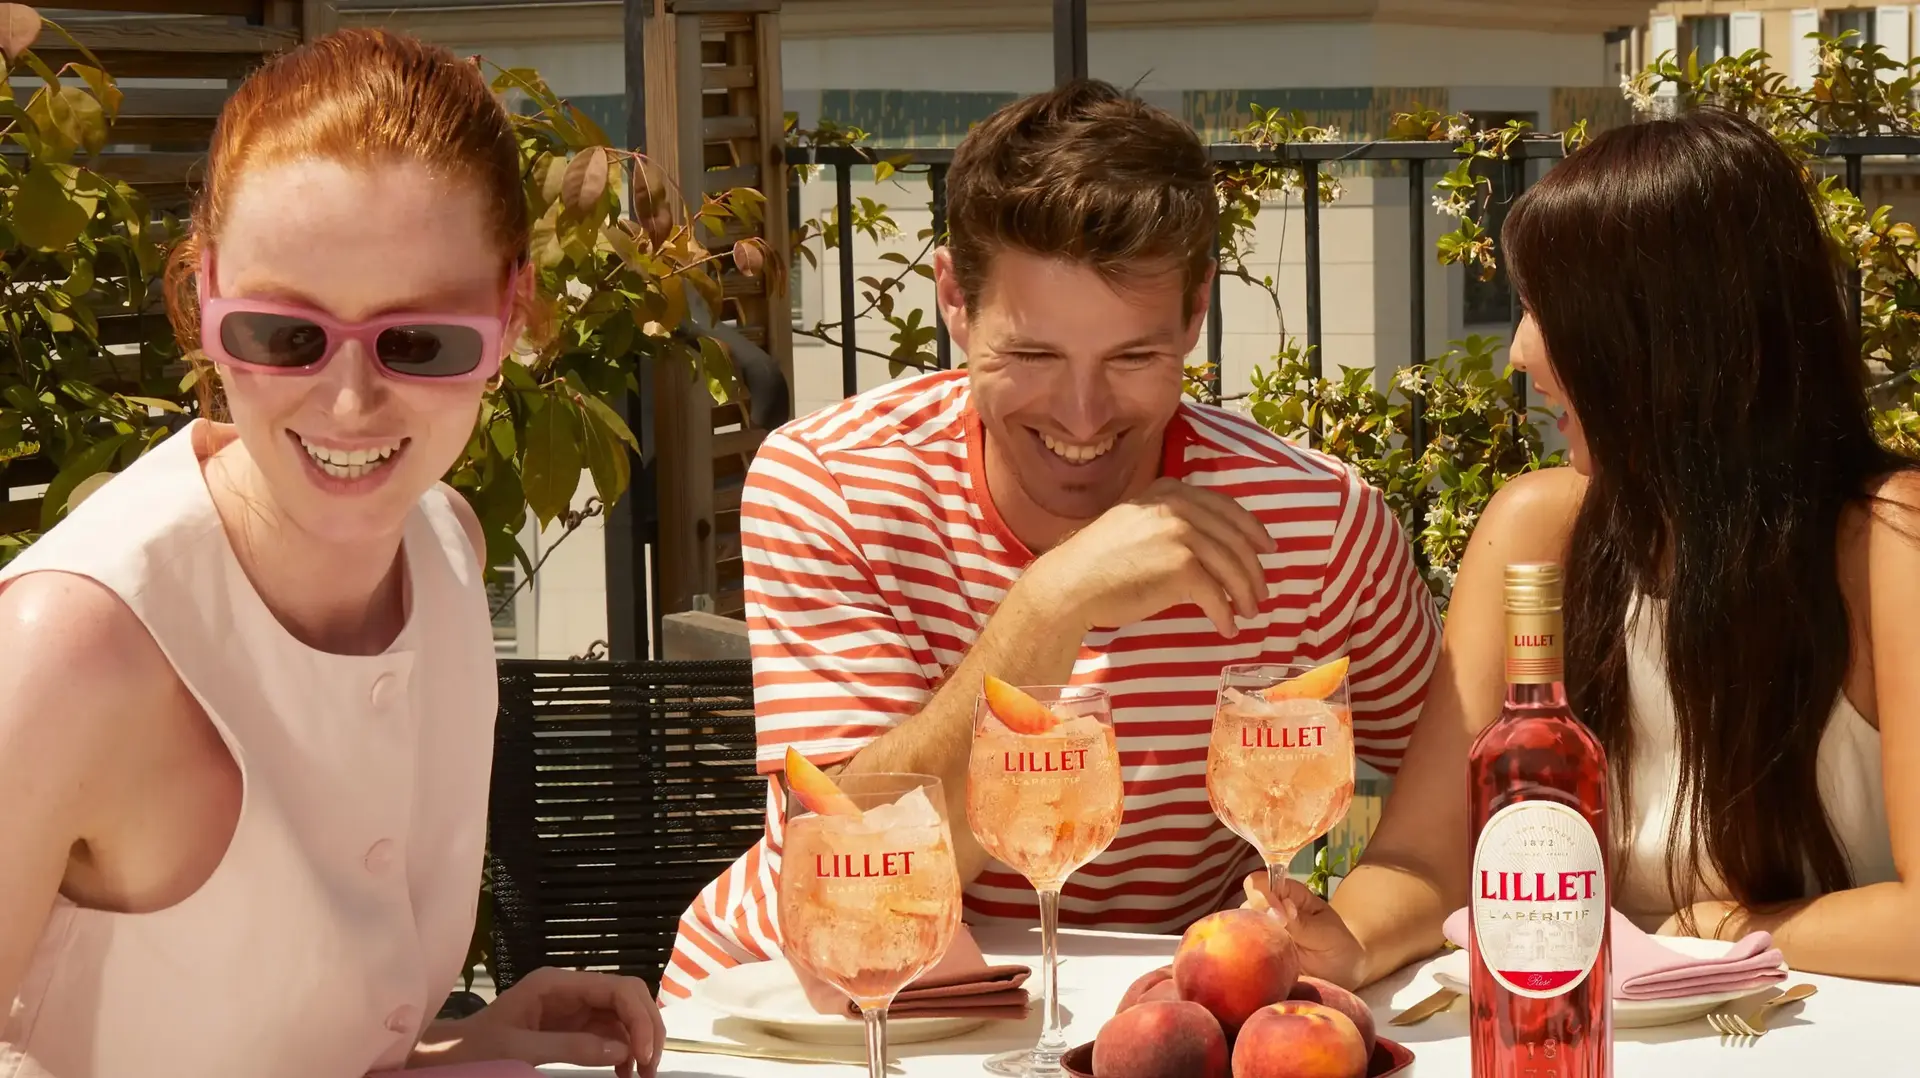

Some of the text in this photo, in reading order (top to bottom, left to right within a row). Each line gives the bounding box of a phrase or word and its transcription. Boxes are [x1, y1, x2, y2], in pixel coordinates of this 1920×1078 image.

[1514, 634, 1555, 647] LILLET
[1242, 726, 1326, 747] LILLET
[1004, 749, 1088, 772] LILLET
[1523, 839, 1554, 847] 1872
[816, 851, 915, 877] LILLET
[1480, 870, 1597, 901] LILLET
[1489, 909, 1590, 921] L'APÉRITIF
[1526, 973, 1552, 987] Rosé
